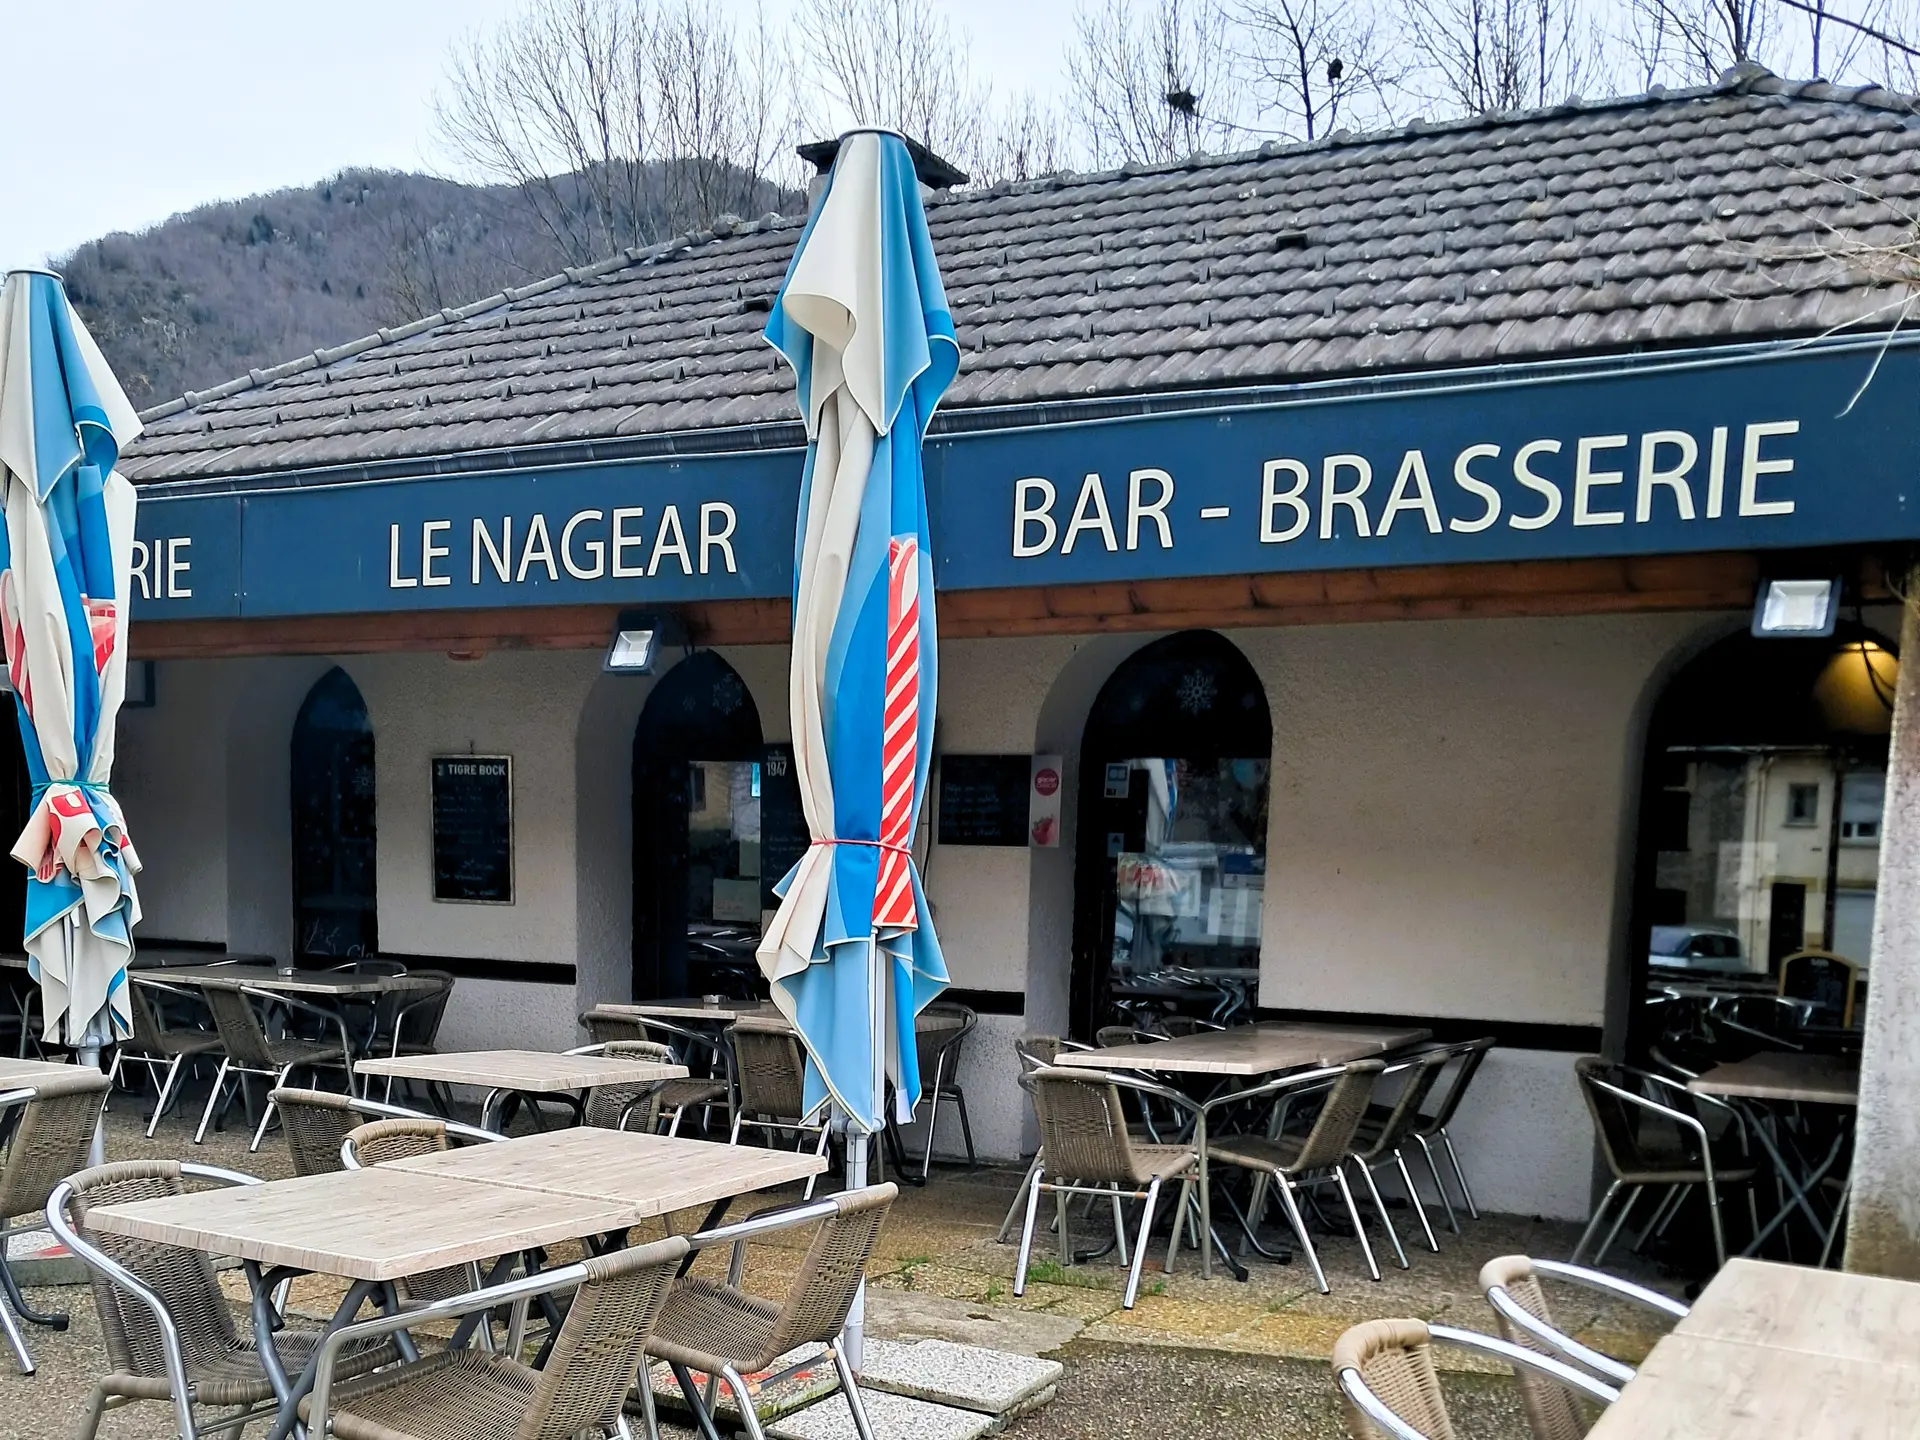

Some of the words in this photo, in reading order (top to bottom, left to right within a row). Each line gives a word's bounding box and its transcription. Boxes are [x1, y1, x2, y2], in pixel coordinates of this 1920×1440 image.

[1011, 467, 1175, 558] BAR
[1258, 419, 1801, 545] BRASSERIE
[388, 520, 452, 589] LE
[471, 501, 738, 585] NAGEAR
[447, 763, 477, 776] TIGRE
[478, 763, 507, 776] BOCK
[765, 760, 788, 777] 1947
